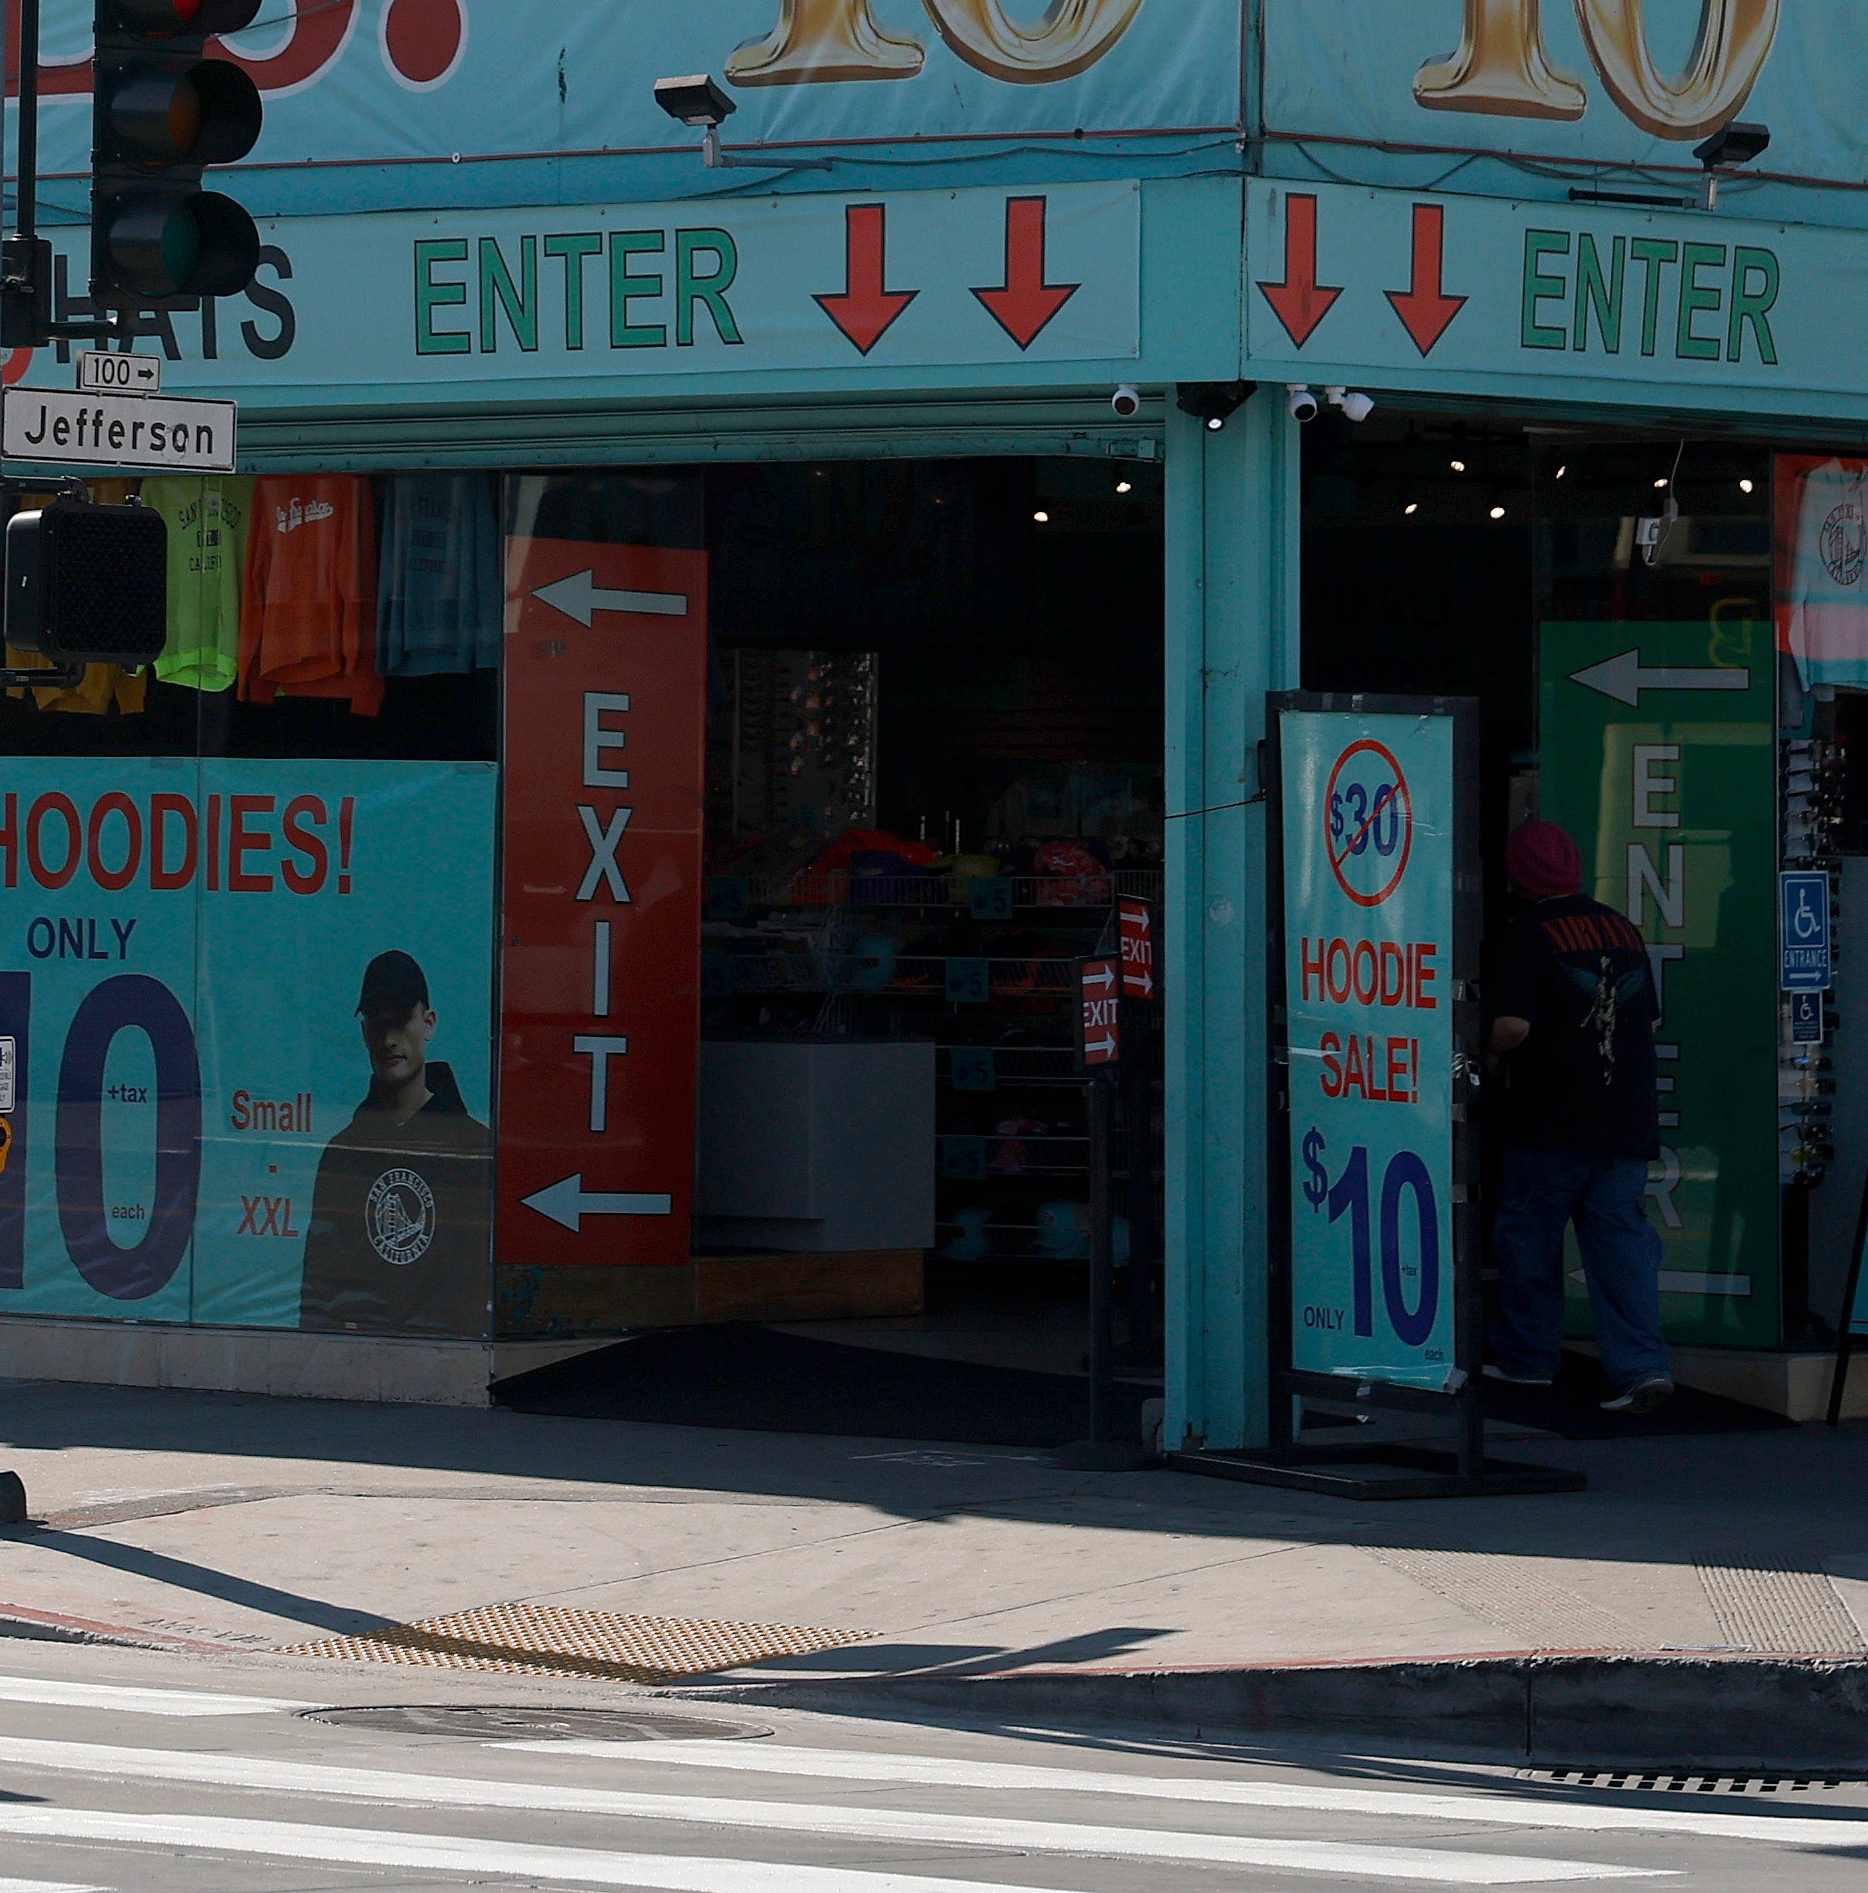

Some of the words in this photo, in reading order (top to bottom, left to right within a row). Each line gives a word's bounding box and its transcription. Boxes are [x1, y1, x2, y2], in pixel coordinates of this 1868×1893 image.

[414, 227, 744, 358] ENTER
[1521, 228, 1781, 367] ENTER
[94, 357, 130, 386] 100
[25, 405, 214, 454] Jefferson
[1330, 780, 1401, 858] $30
[574, 691, 633, 1133] EXIT
[27, 917, 137, 961] ONLY
[1119, 936, 1153, 965] EXIT
[1784, 949, 1828, 968] ENTRANCE
[1301, 935, 1438, 1013] HOODIE
[1082, 997, 1119, 1029] EXIT
[1320, 1030, 1420, 1105] SALE!
[107, 1082, 149, 1106] +tax
[231, 1089, 313, 1132] Small
[111, 1204, 146, 1221] each
[236, 1195, 299, 1237] XXL
[1303, 1126, 1439, 1347] $10
[1303, 1306, 1344, 1331] ONLY
